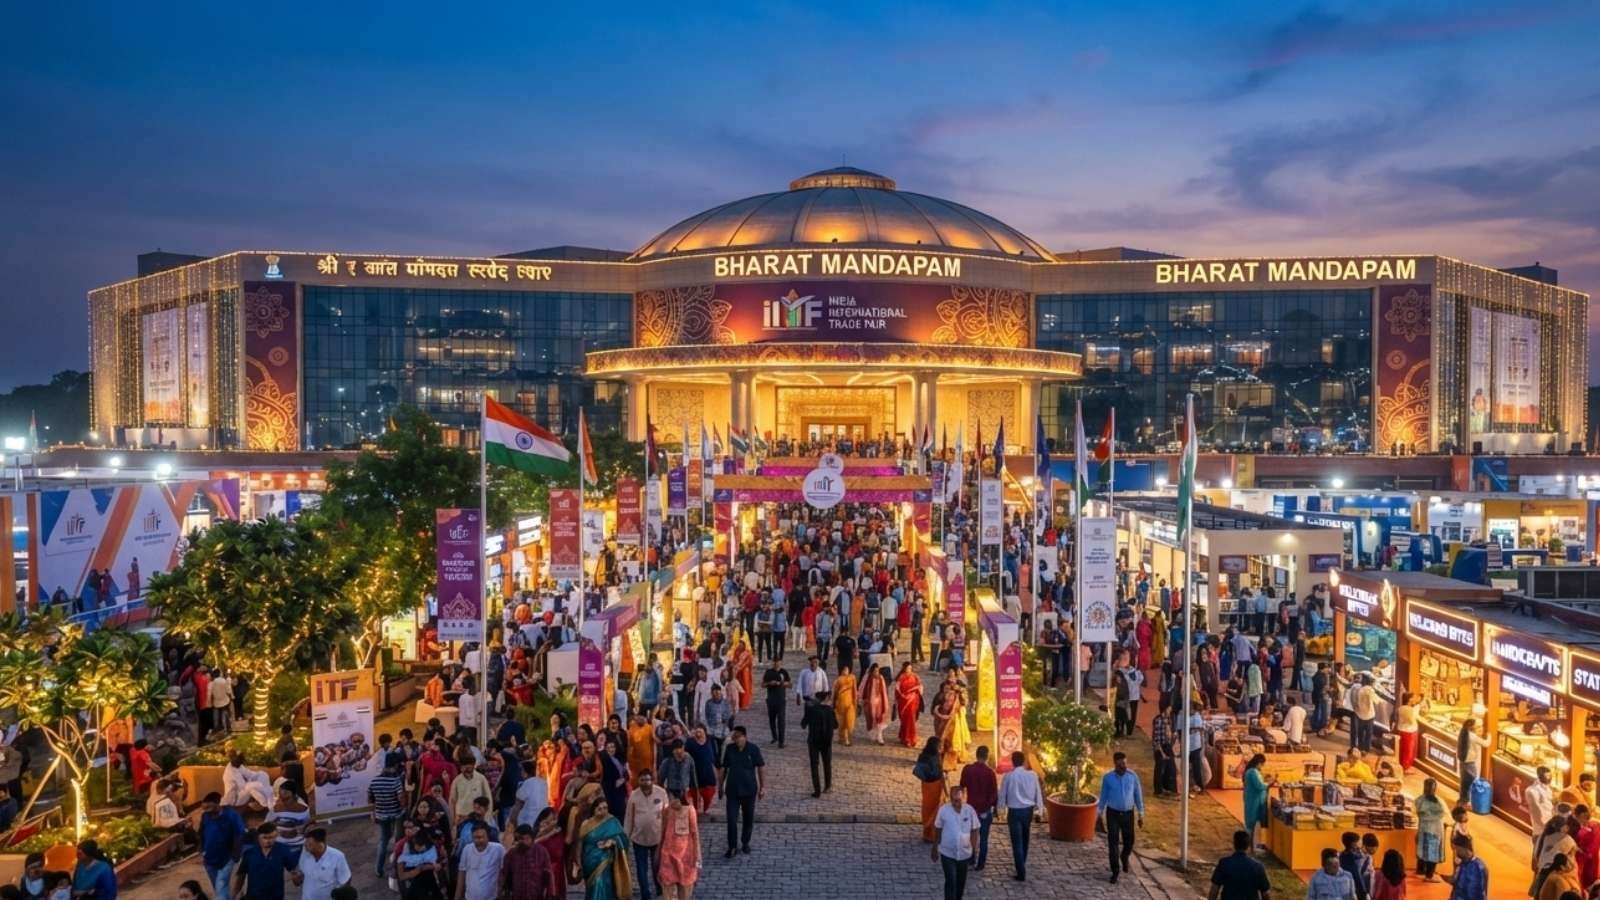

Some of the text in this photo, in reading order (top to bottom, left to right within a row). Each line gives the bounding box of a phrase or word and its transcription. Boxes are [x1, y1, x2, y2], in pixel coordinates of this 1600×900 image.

[714, 253, 961, 278] BHARAT MANDAPAM
[1155, 259, 1416, 284] BHARAT MANDAPAM
